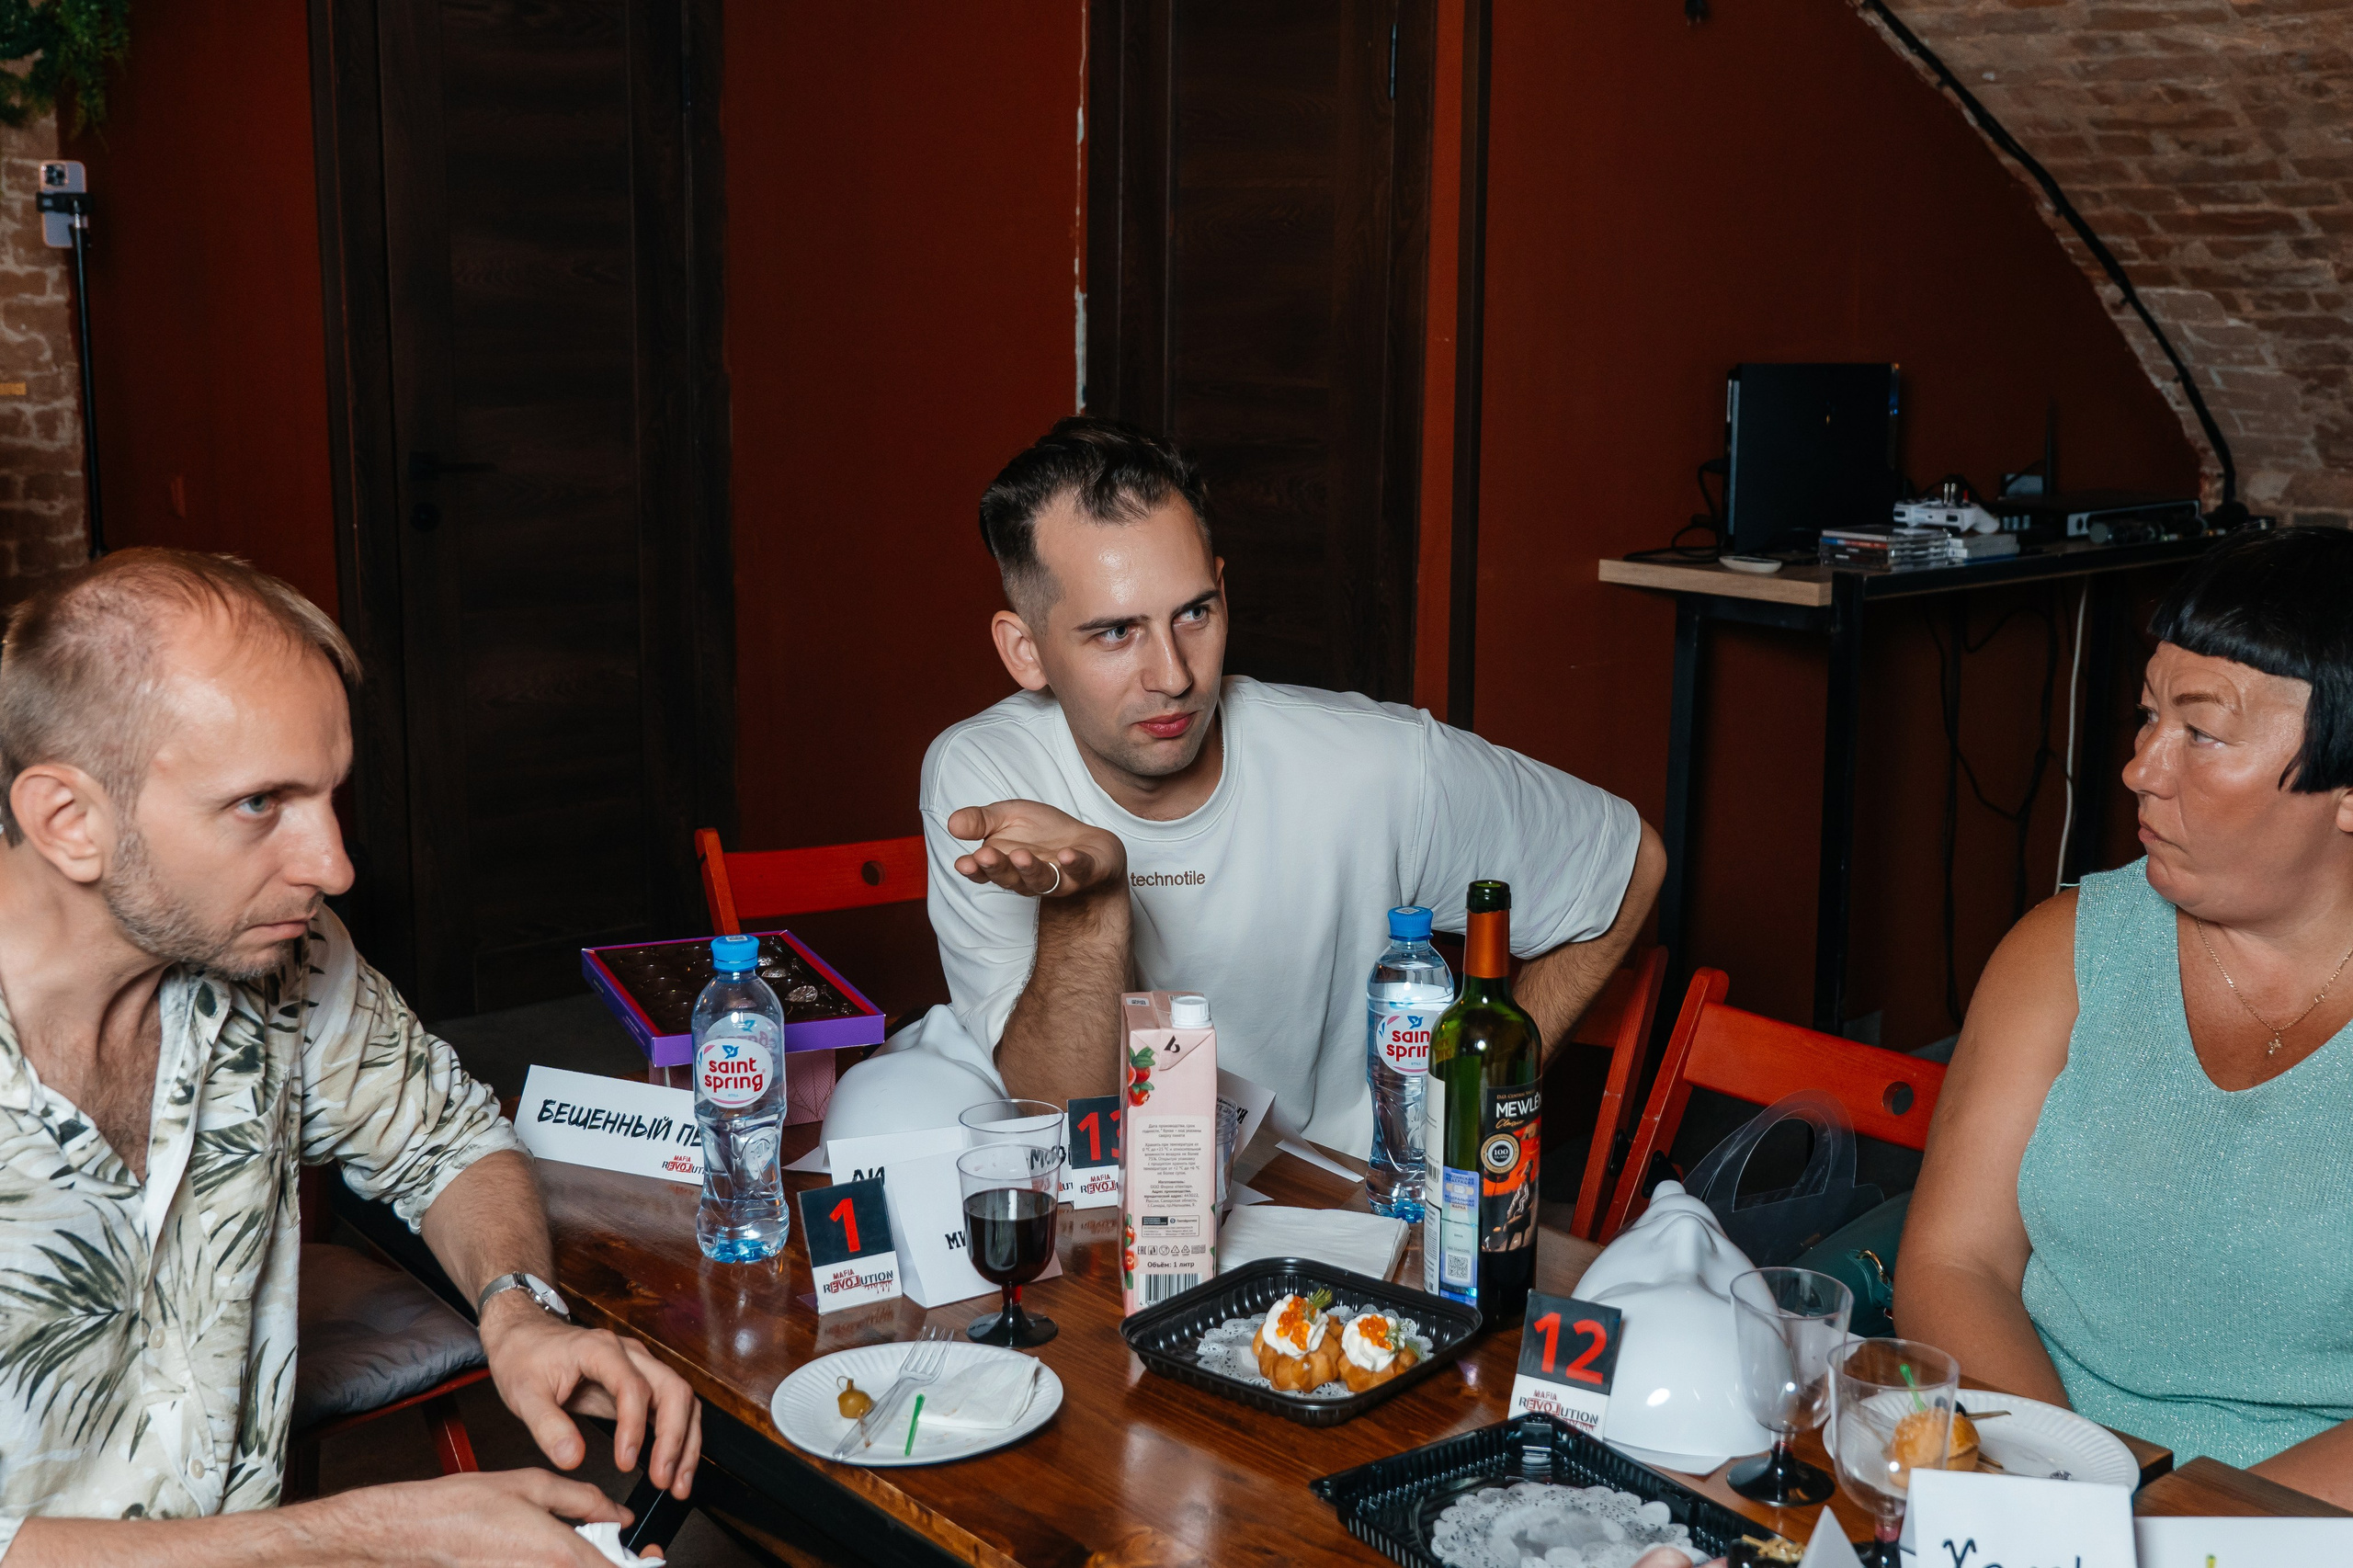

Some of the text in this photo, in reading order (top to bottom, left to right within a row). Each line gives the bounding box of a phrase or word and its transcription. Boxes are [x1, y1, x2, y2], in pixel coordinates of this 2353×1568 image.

[1131, 870, 1206, 887] technotile
[1392, 1030, 1430, 1043] sain
[709, 1057, 757, 1074] saint
[704, 1074, 763, 1093] spring
[538, 1098, 674, 1142] БЕШЕННЫЙ
[674, 1154, 691, 1163] MAFIA
[1090, 1174, 1111, 1182] MAFIA
[829, 1198, 861, 1253] 1
[833, 1268, 855, 1279] MAFIA
[1533, 1312, 1608, 1385] 12
[1533, 1390, 1558, 1401] MAFIA
